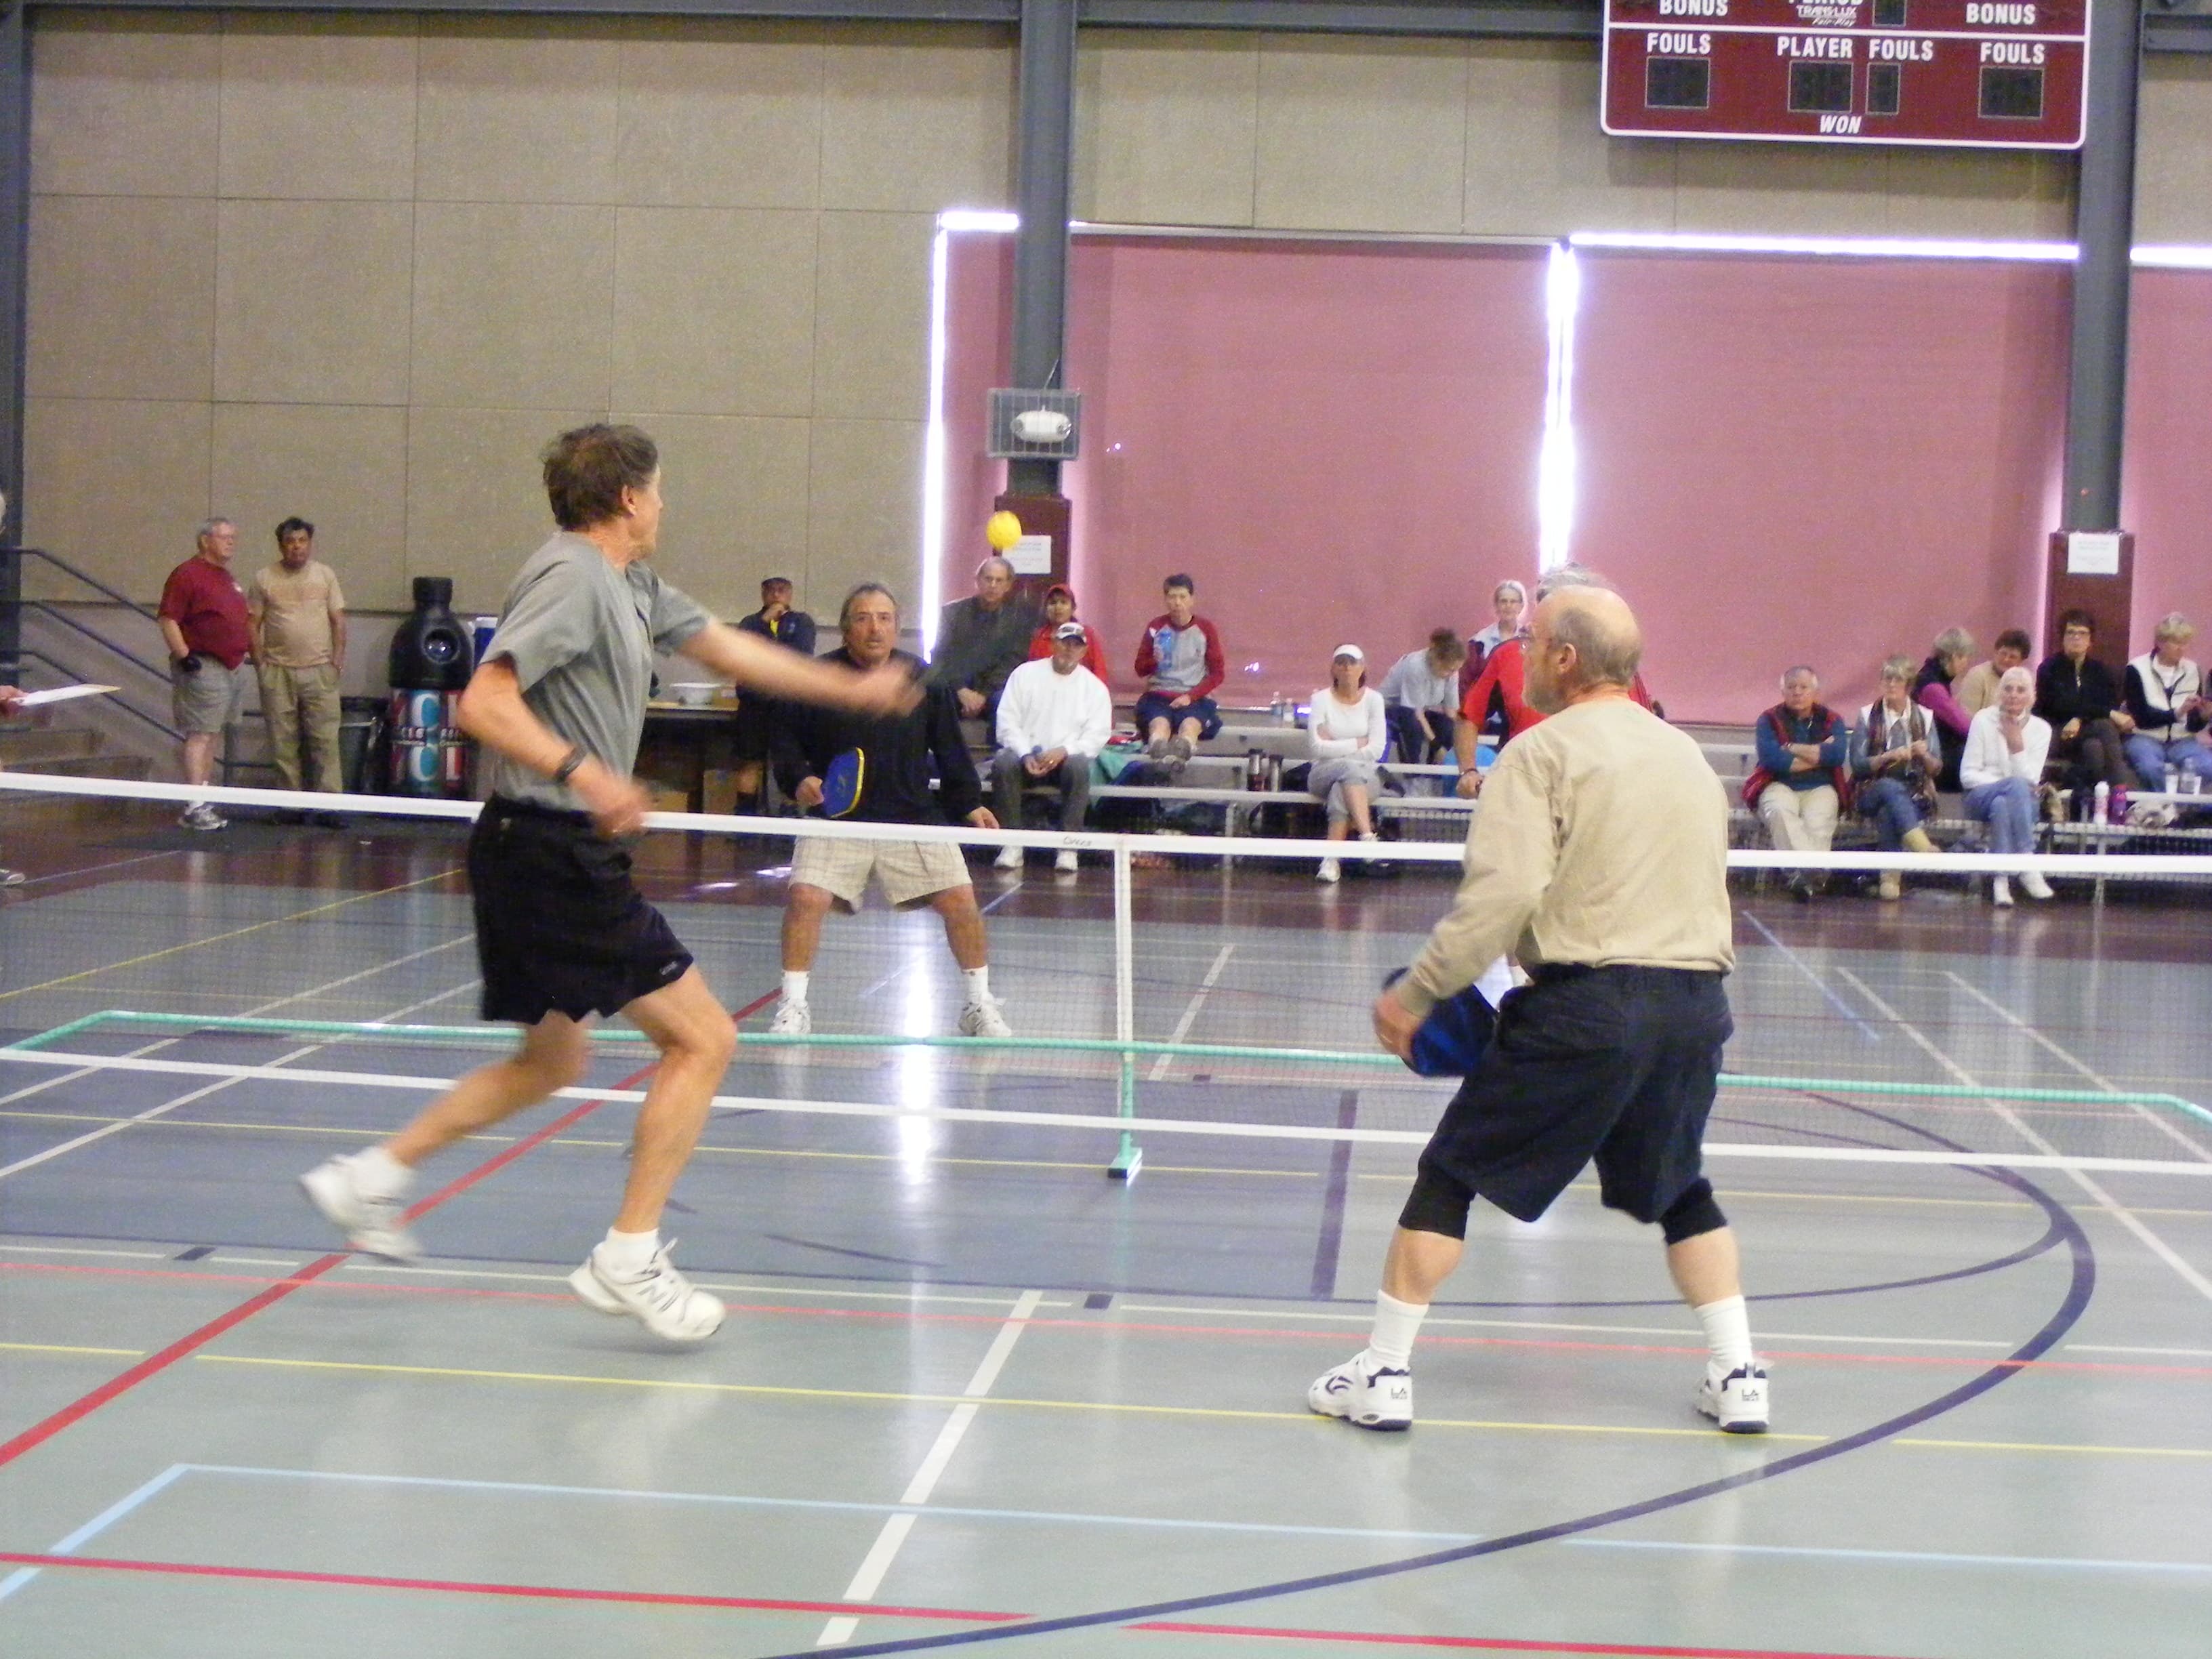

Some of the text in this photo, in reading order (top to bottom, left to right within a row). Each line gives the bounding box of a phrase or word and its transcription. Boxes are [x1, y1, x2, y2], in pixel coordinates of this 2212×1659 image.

[1660, 0, 1727, 16] BONUS
[1966, 2, 2036, 24] BONUS
[1647, 33, 1711, 54] FOULS
[1777, 36, 1933, 61] PLAYER FOULS
[1980, 42, 2045, 64] FOULS
[1820, 114, 1862, 134] WON
